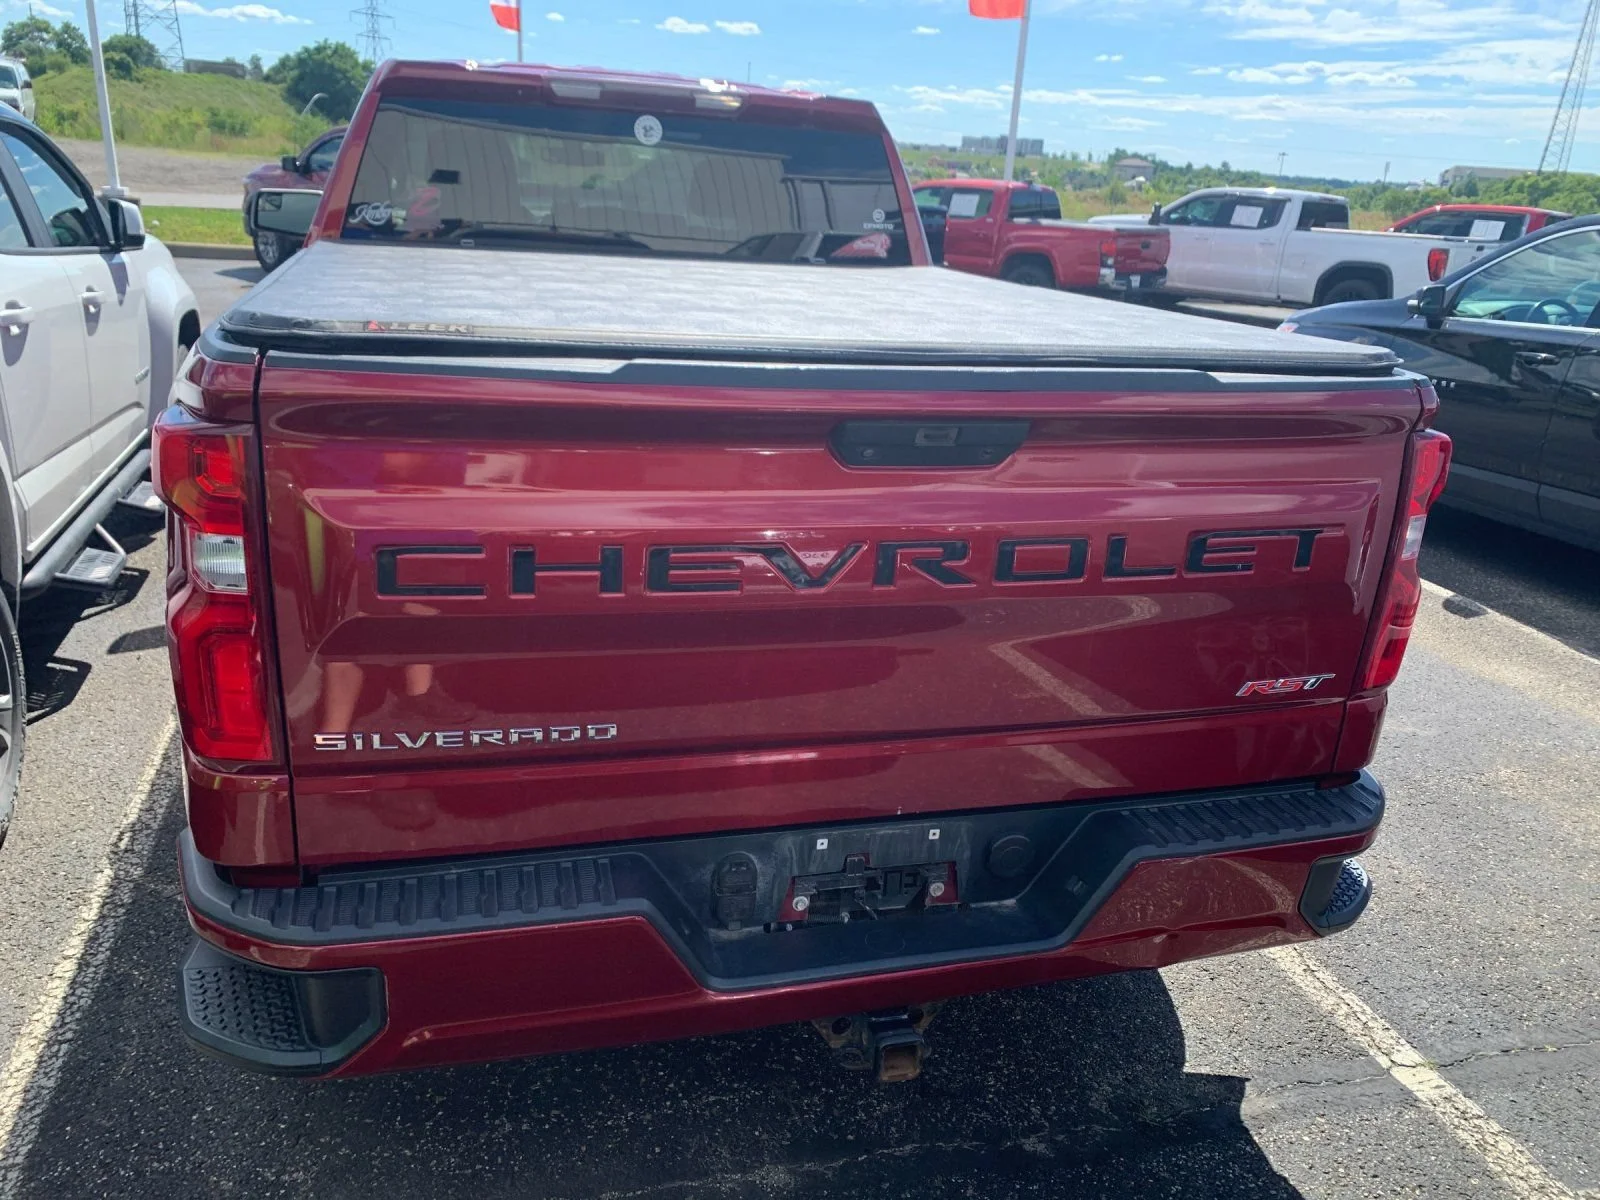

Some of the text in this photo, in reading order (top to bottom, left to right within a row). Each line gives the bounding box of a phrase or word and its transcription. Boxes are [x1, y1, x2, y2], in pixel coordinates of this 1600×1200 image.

[374, 526, 1343, 599] CHEVROLET
[1235, 673, 1336, 697] RST
[313, 723, 617, 751] SILVERADO
